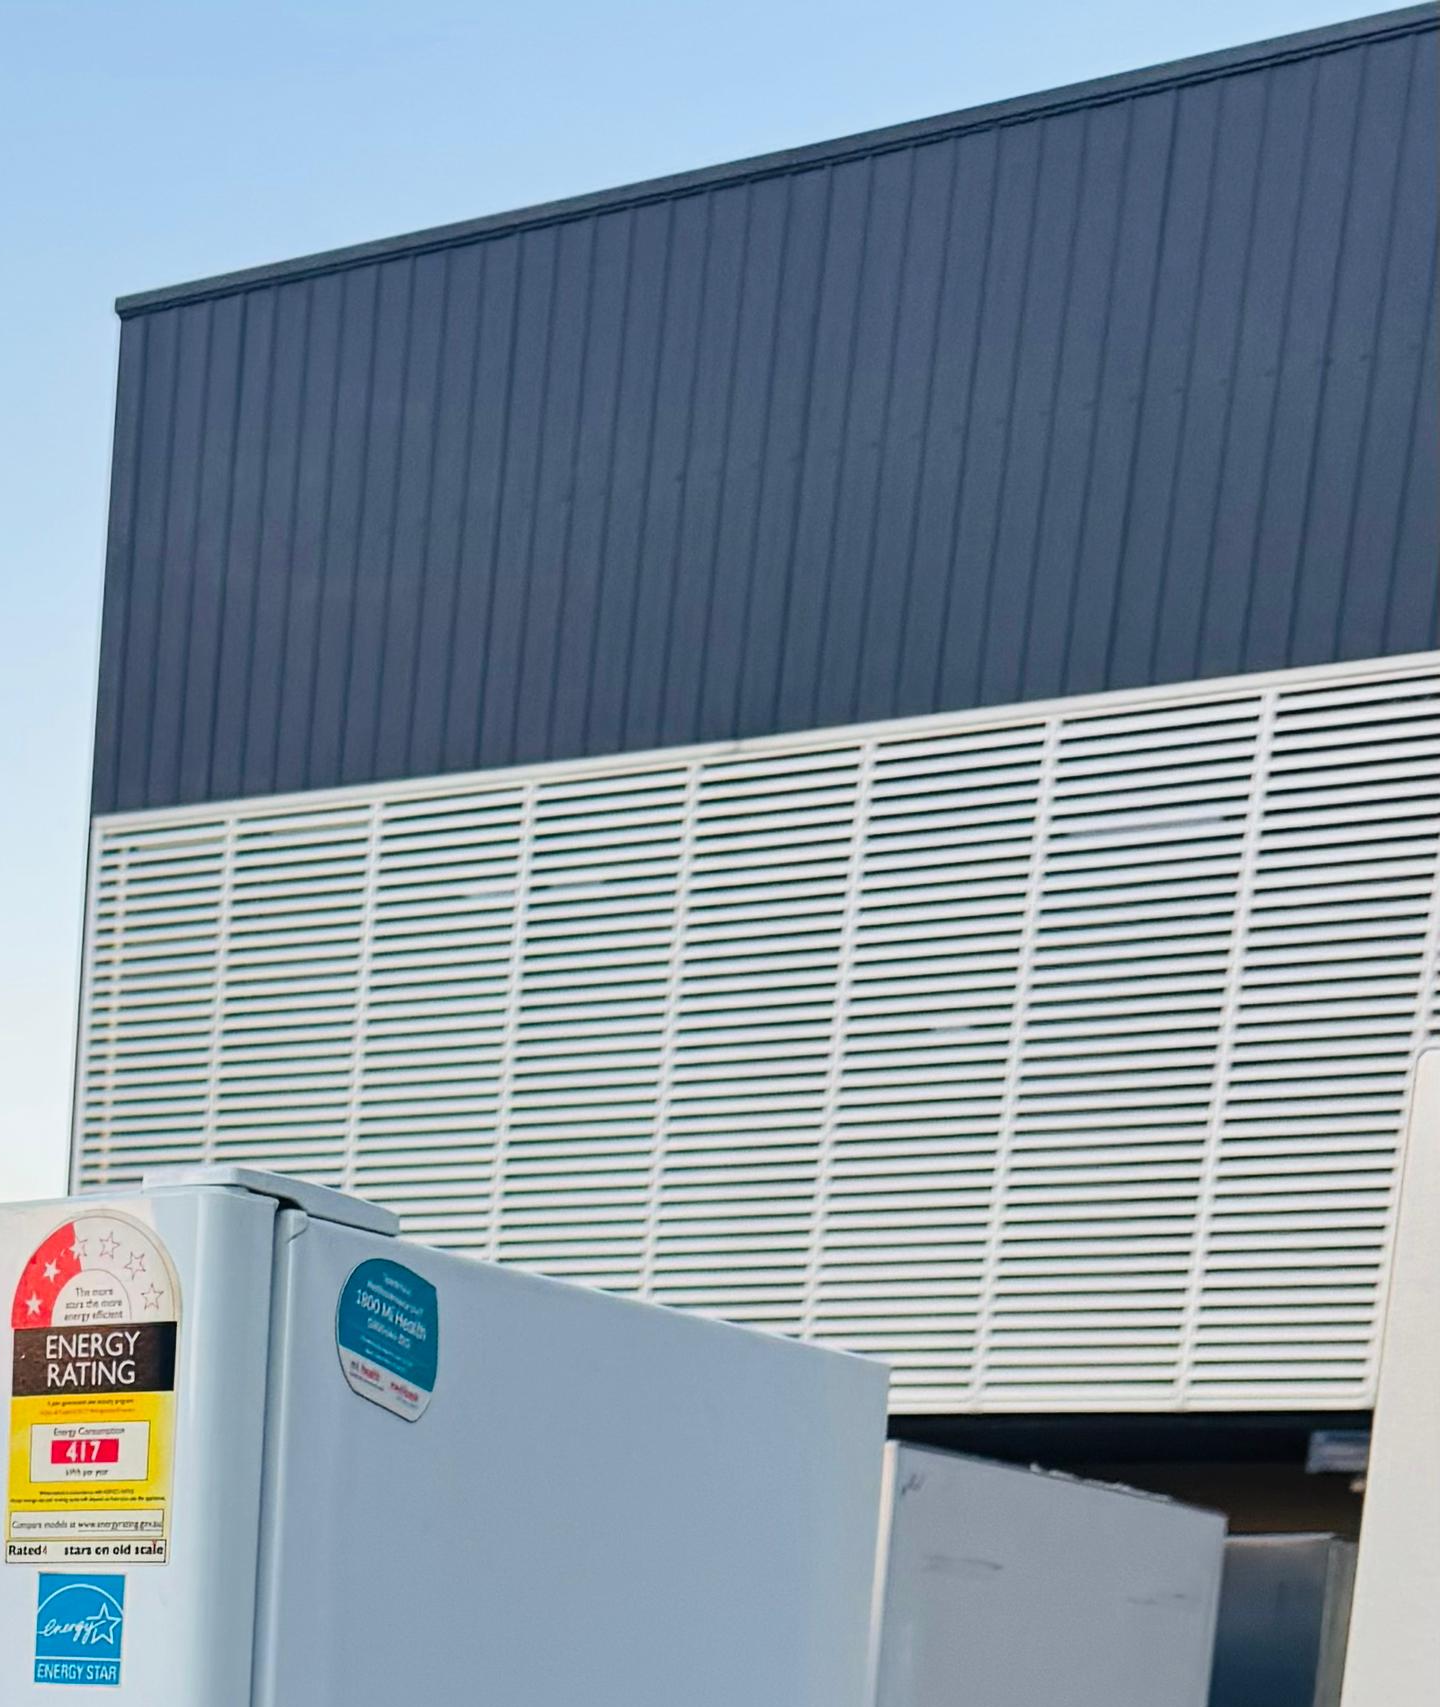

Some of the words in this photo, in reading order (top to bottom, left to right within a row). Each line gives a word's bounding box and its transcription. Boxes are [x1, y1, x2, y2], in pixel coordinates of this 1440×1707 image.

[75, 1287, 90, 1297] The
[45, 1330, 141, 1360] ENERGY
[46, 1360, 136, 1388] RATING
[53, 1428, 77, 1438] Energy
[78, 1427, 126, 1436] Consumption
[65, 1440, 101, 1463] 417
[12, 1520, 42, 1531] Compare
[44, 1519, 68, 1529] models
[8, 1544, 42, 1556] Rated
[64, 1545, 92, 1556] stars
[95, 1546, 110, 1556] on
[112, 1544, 131, 1556] old
[134, 1543, 164, 1556] scale
[37, 1618, 101, 1645] energy
[36, 1662, 83, 1680] ENERGY
[86, 1664, 117, 1681] STAR
